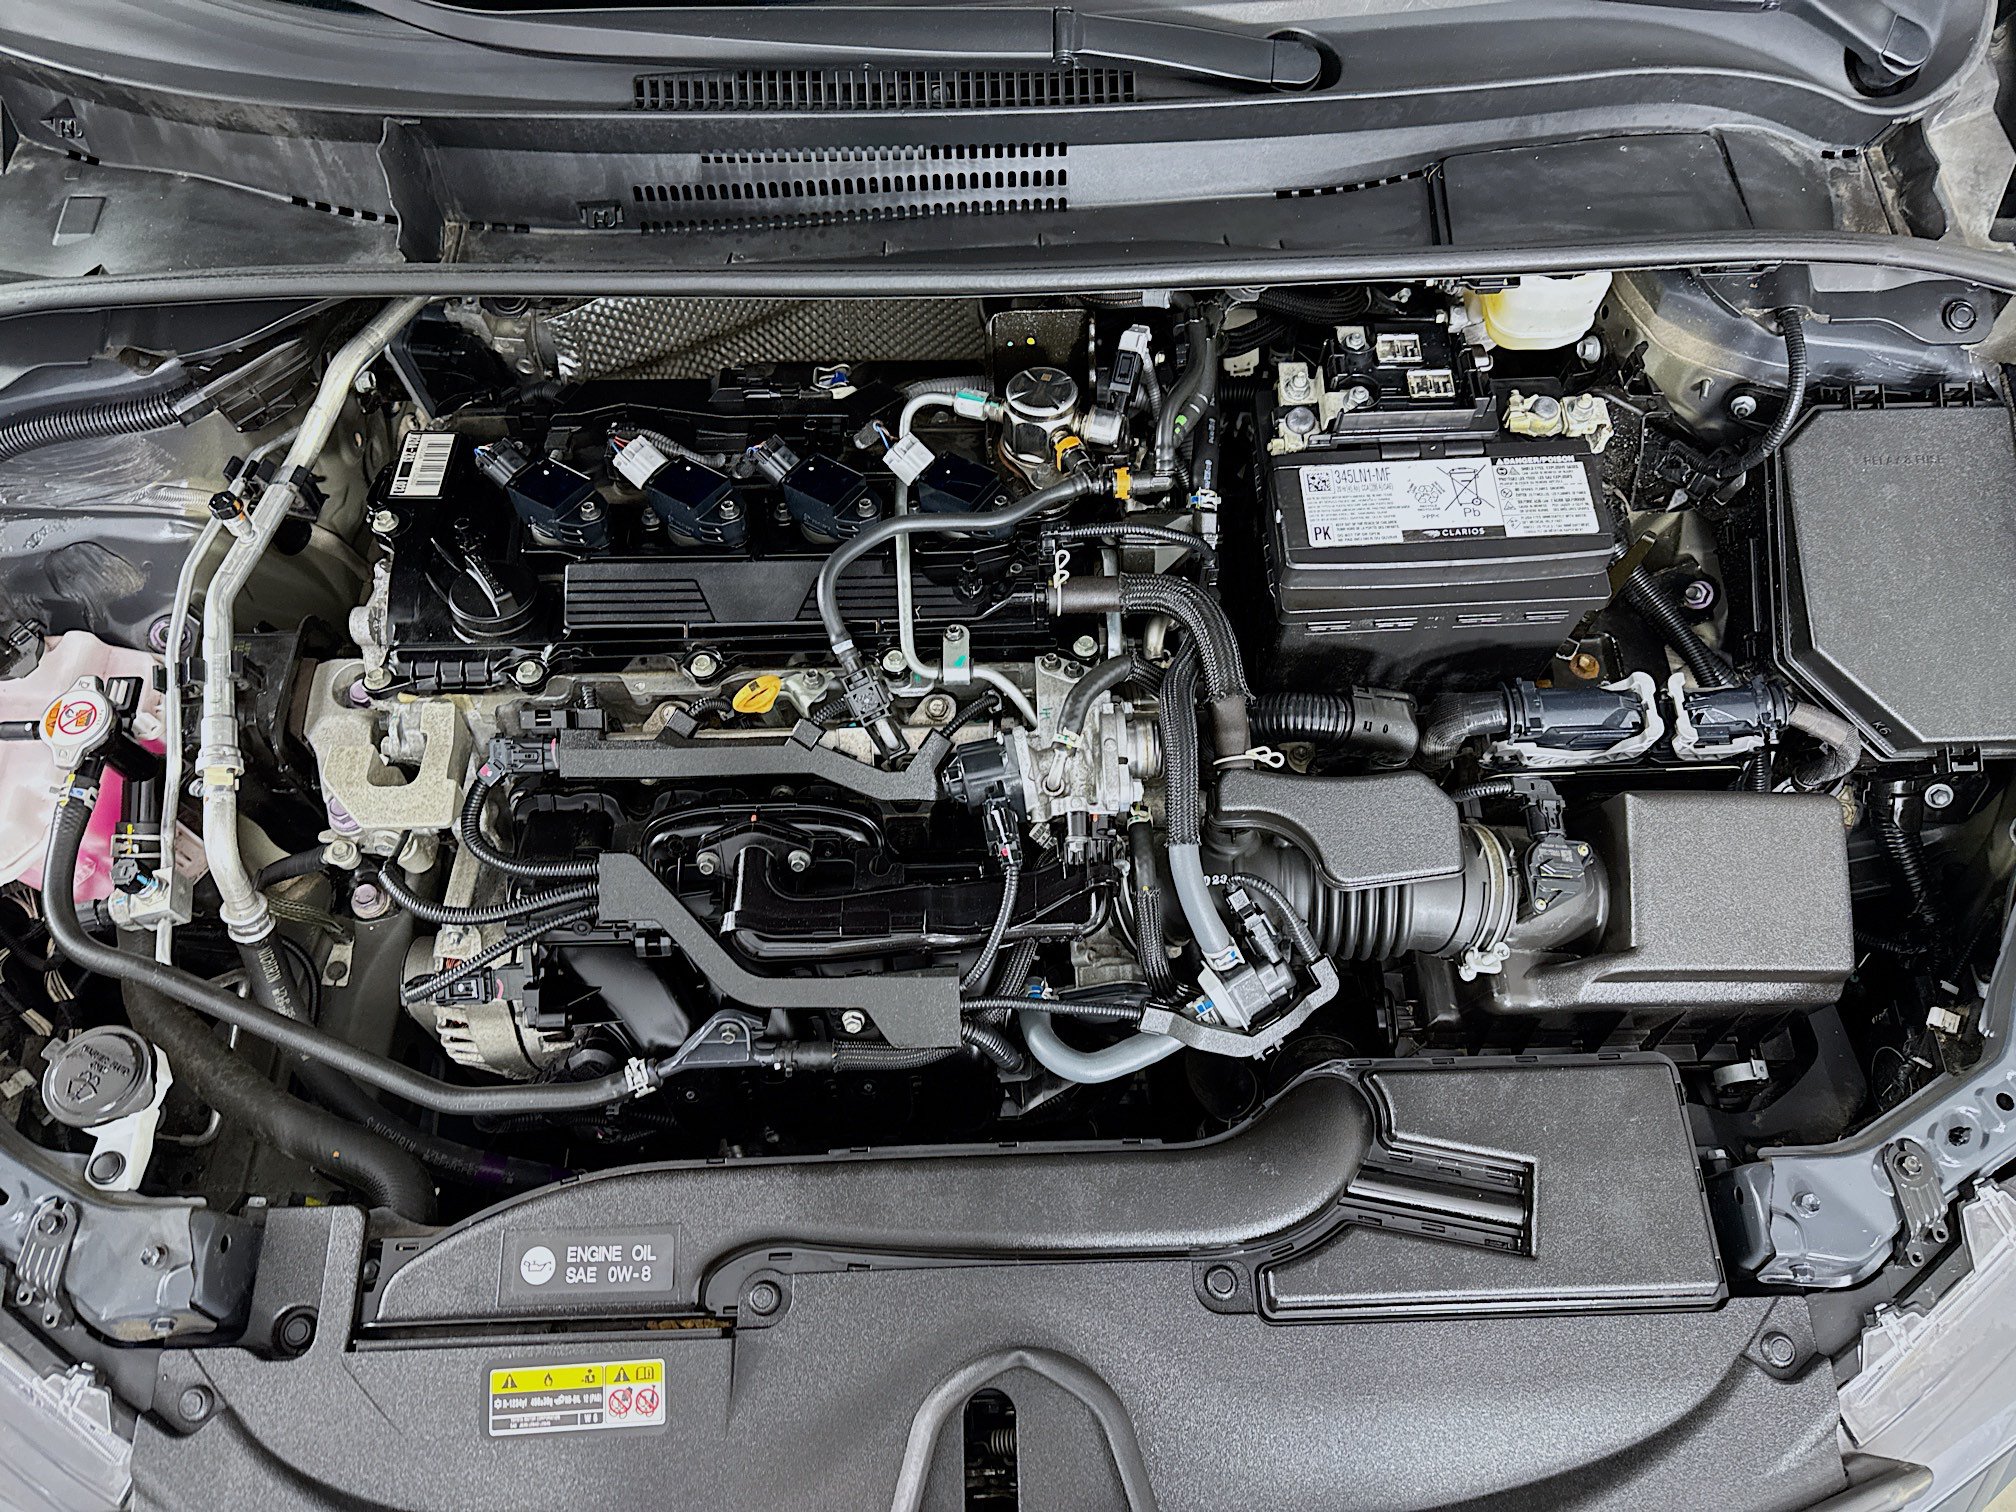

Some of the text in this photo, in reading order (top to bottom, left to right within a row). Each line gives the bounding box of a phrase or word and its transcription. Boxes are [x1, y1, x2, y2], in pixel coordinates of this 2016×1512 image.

[1334, 467, 1391, 484] 345LN1-MF
[1463, 507, 1481, 517] Pb
[1314, 526, 1332, 541] PK
[1441, 527, 1485, 537] CLARIOS
[566, 1244, 657, 1263] ENGINE OIL
[565, 1265, 652, 1284] SAE 0W-8
